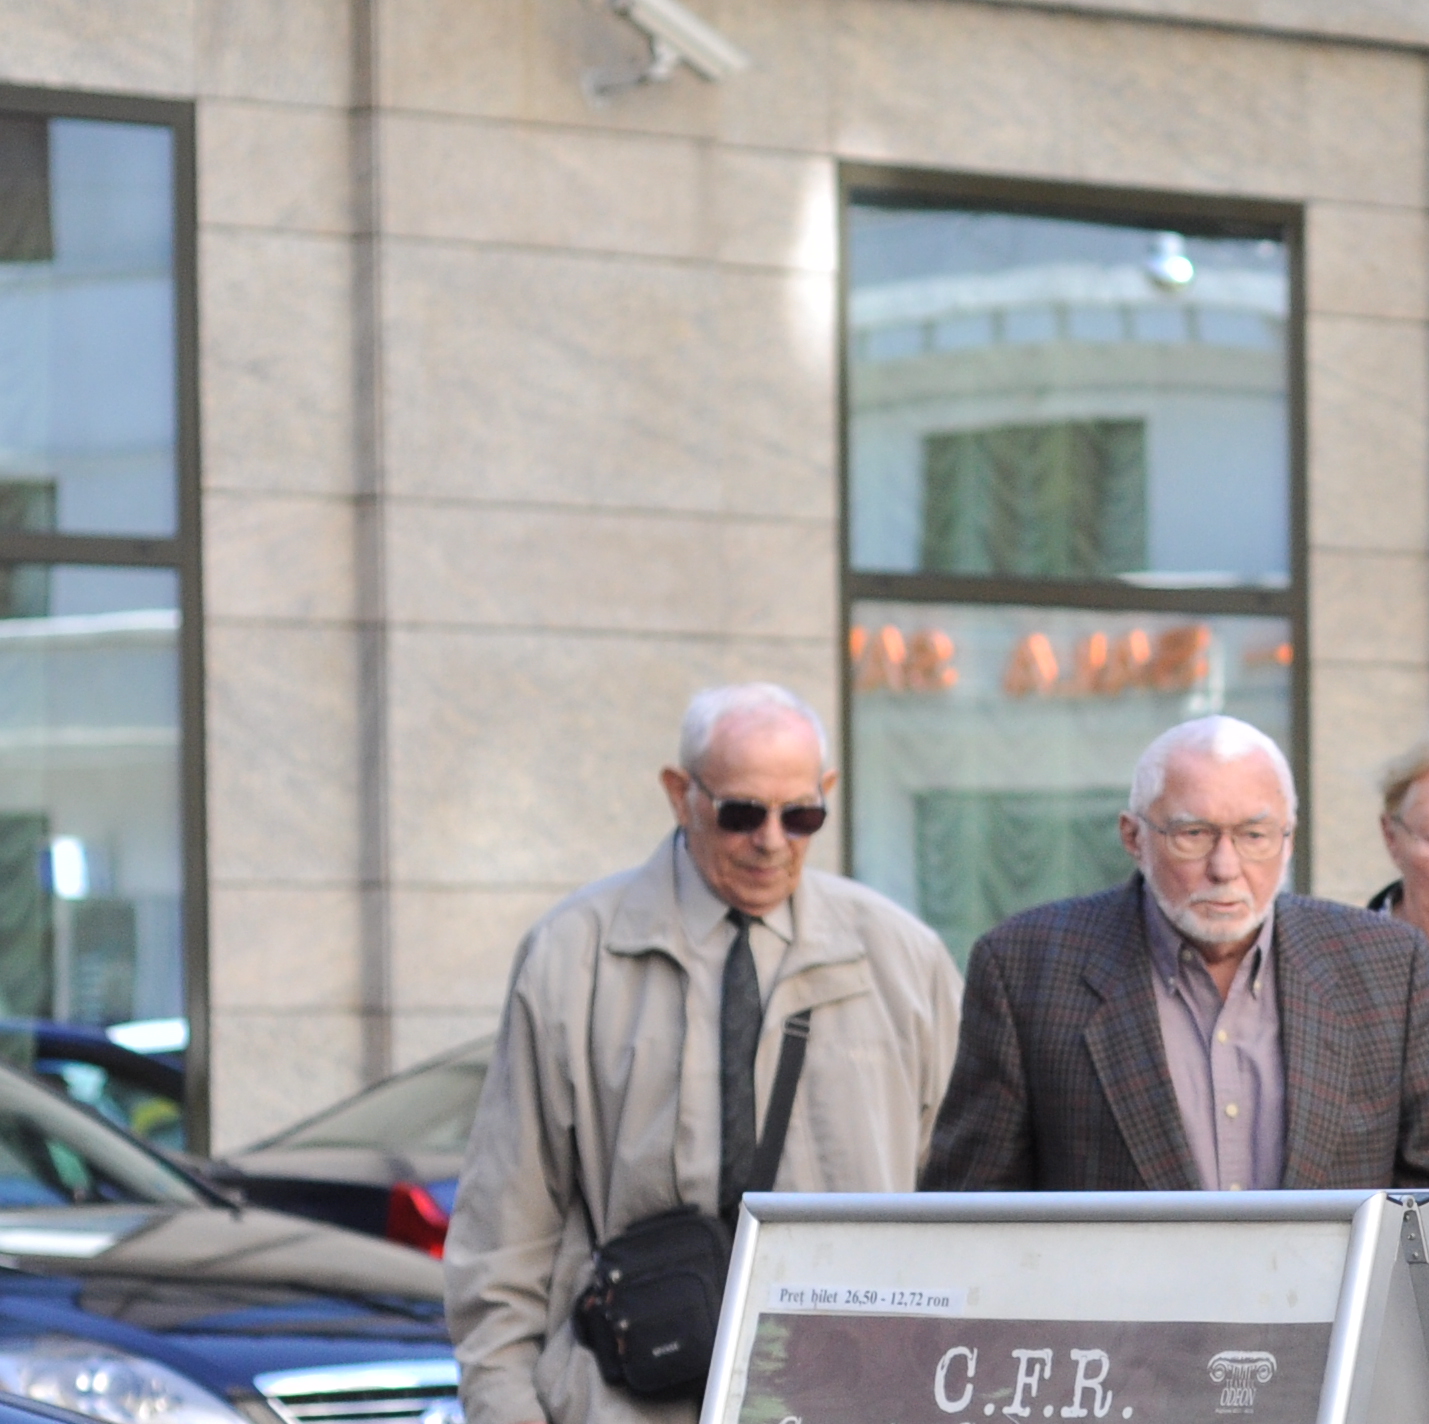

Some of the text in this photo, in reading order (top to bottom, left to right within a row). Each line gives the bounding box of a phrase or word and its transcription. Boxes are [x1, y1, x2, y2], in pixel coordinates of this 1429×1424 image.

[811, 1288, 838, 1304] bilet
[844, 1289, 878, 1306] 26,50
[890, 1291, 924, 1307] 12,72
[926, 1294, 949, 1307] ron
[934, 1346, 1134, 1419] C.F.R.
[1220, 1388, 1257, 1406] ODEON
